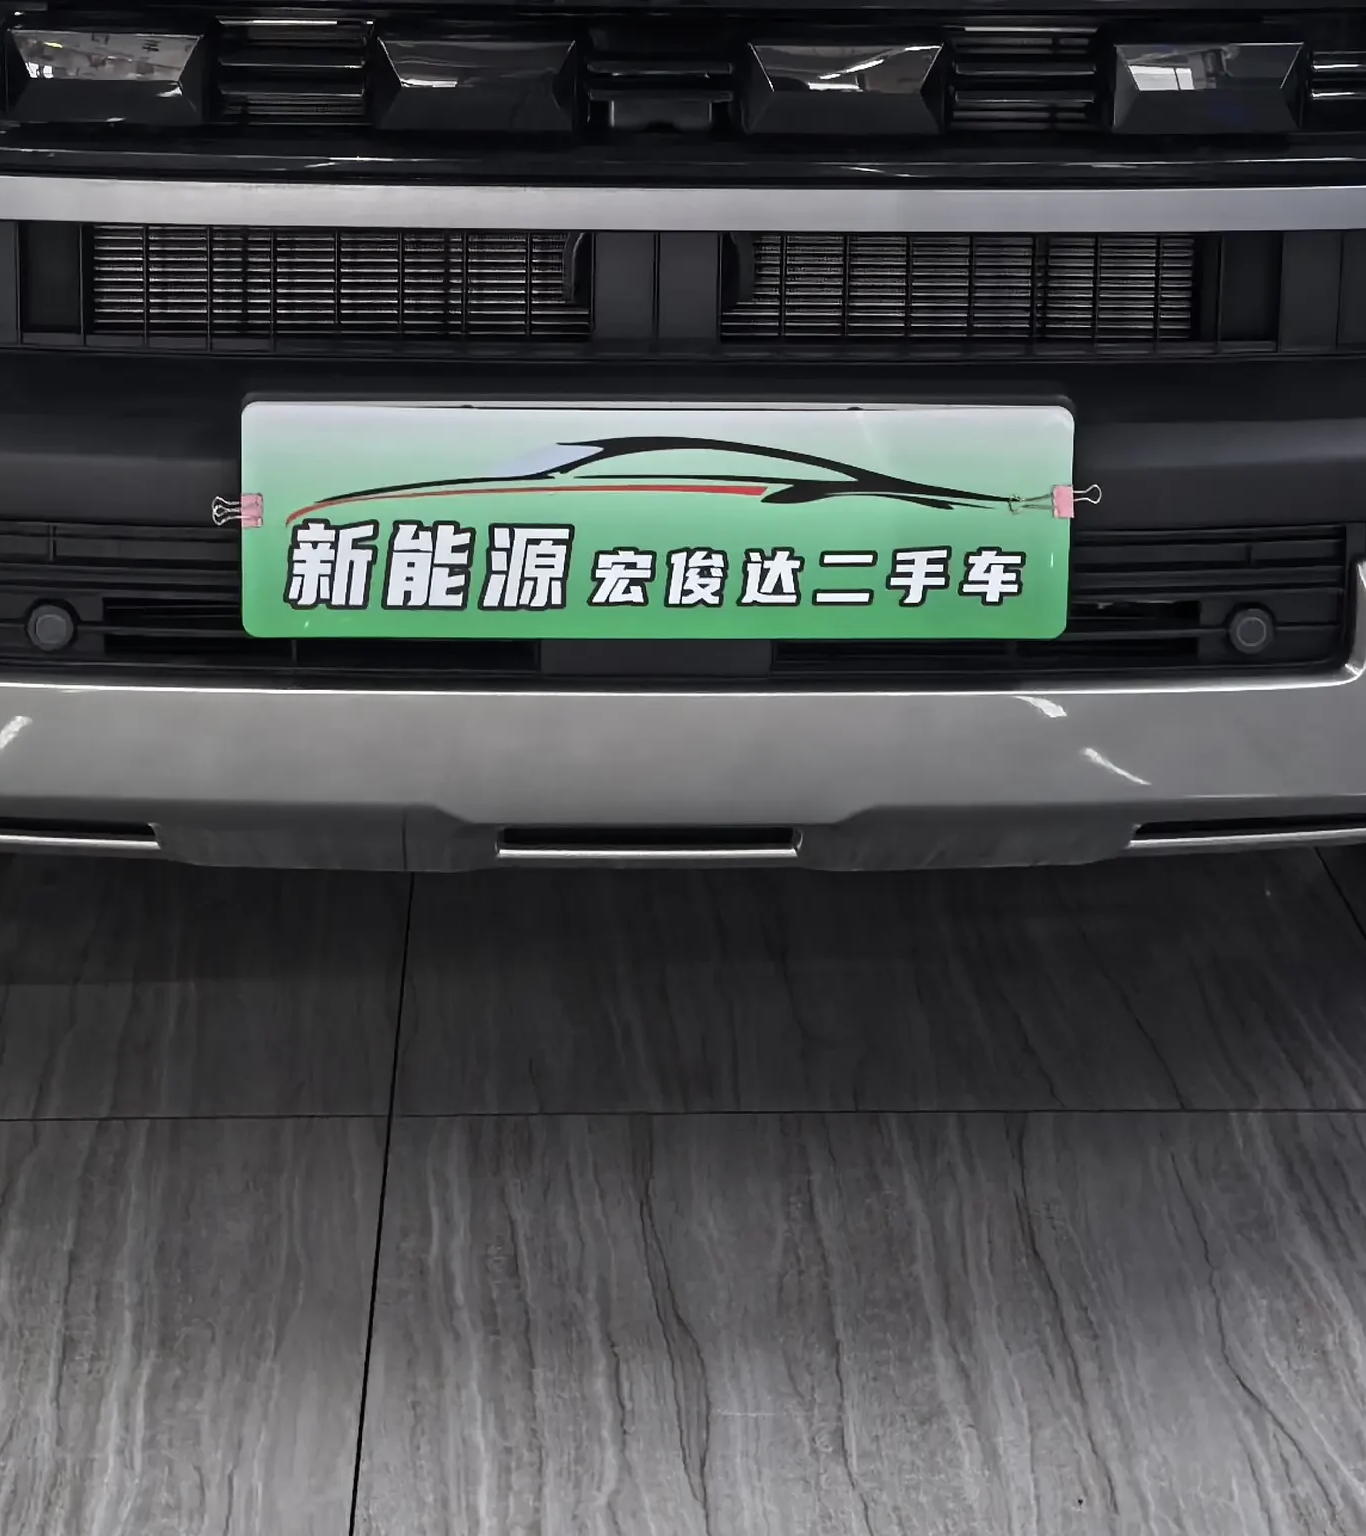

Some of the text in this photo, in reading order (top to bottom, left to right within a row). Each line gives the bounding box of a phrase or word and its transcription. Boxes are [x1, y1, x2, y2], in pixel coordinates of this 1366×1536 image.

[287, 517, 1030, 611] 新能源 宏俊达二手车
